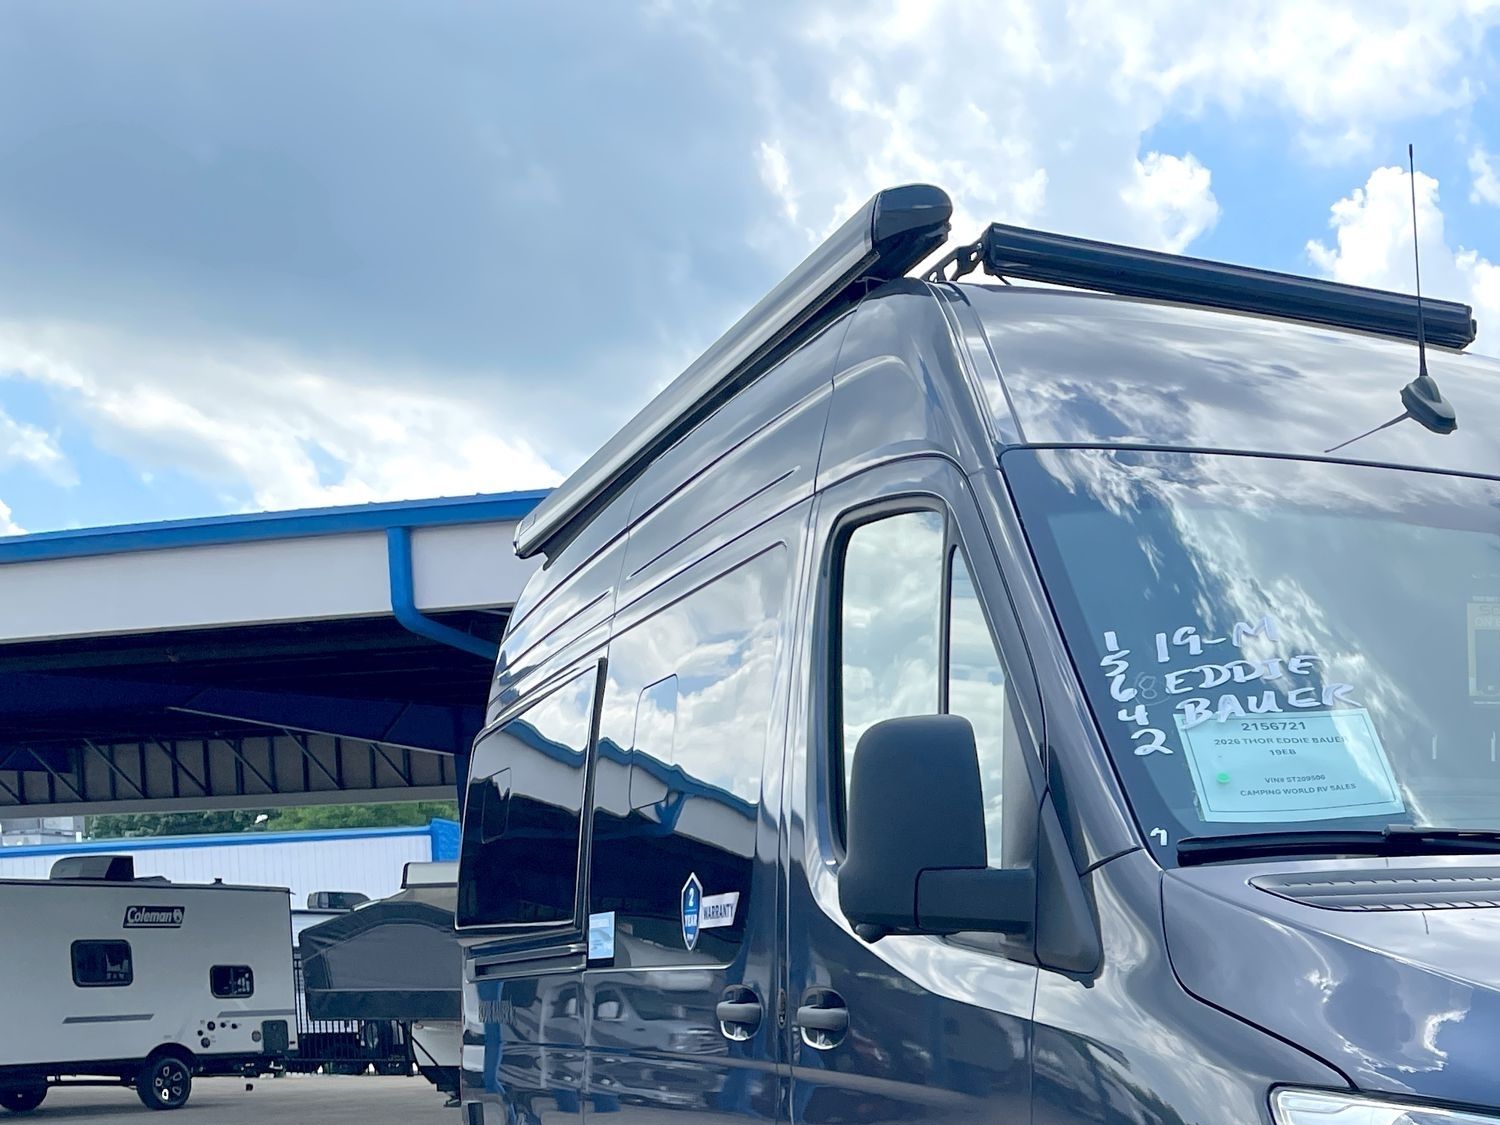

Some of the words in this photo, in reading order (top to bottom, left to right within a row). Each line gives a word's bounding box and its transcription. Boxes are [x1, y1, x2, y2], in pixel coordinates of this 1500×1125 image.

[1165, 654, 1328, 694] EDDIE
[1175, 682, 1362, 730] BAUER
[1241, 721, 1307, 731] 2156721
[1276, 736, 1311, 744] EDDIE
[1282, 786, 1315, 795] WORLD
[1317, 785, 1328, 793] RV
[1330, 783, 1357, 791] SALES
[688, 887, 694, 906] 2
[127, 907, 172, 923] Coleman
[703, 903, 735, 920] WARRANTY
